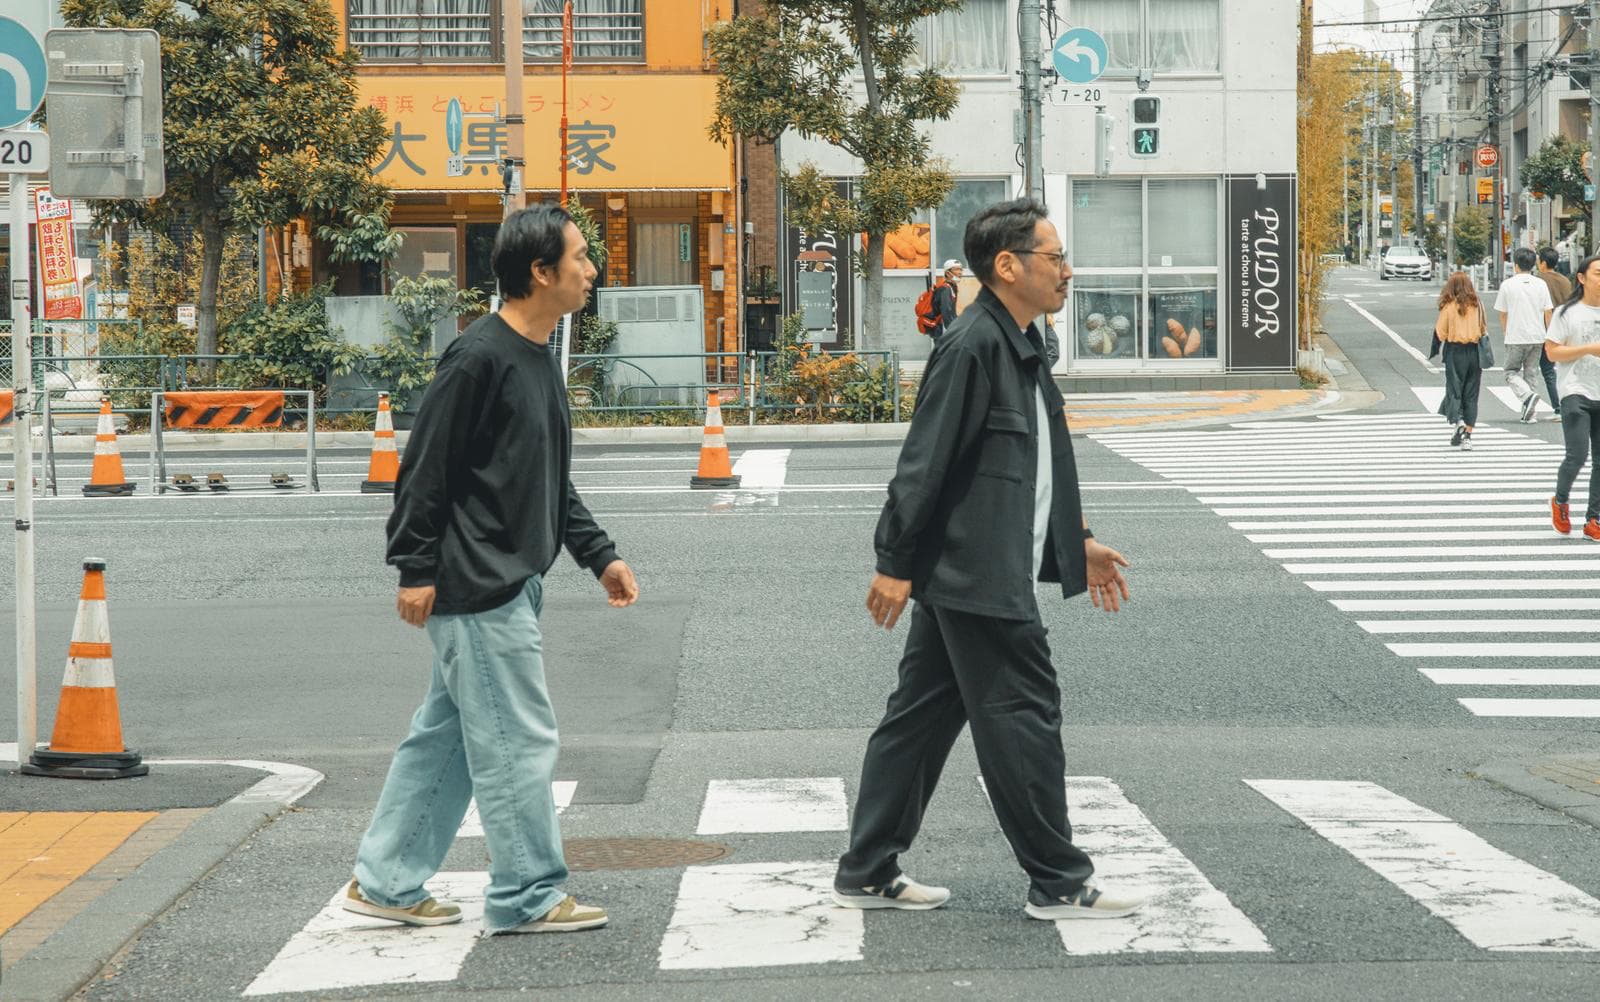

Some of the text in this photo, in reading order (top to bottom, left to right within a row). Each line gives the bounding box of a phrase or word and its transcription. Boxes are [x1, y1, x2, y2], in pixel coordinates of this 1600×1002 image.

[370, 95, 414, 113] 横浜
[1061, 89, 1101, 102] 7-20
[1241, 219, 1250, 241] tarte
[1241, 243, 1250, 253] at
[1241, 255, 1251, 278] chou
[1254, 207, 1280, 339] PUDOR
[1241, 289, 1251, 297] la
[1241, 298, 1249, 328] creme
